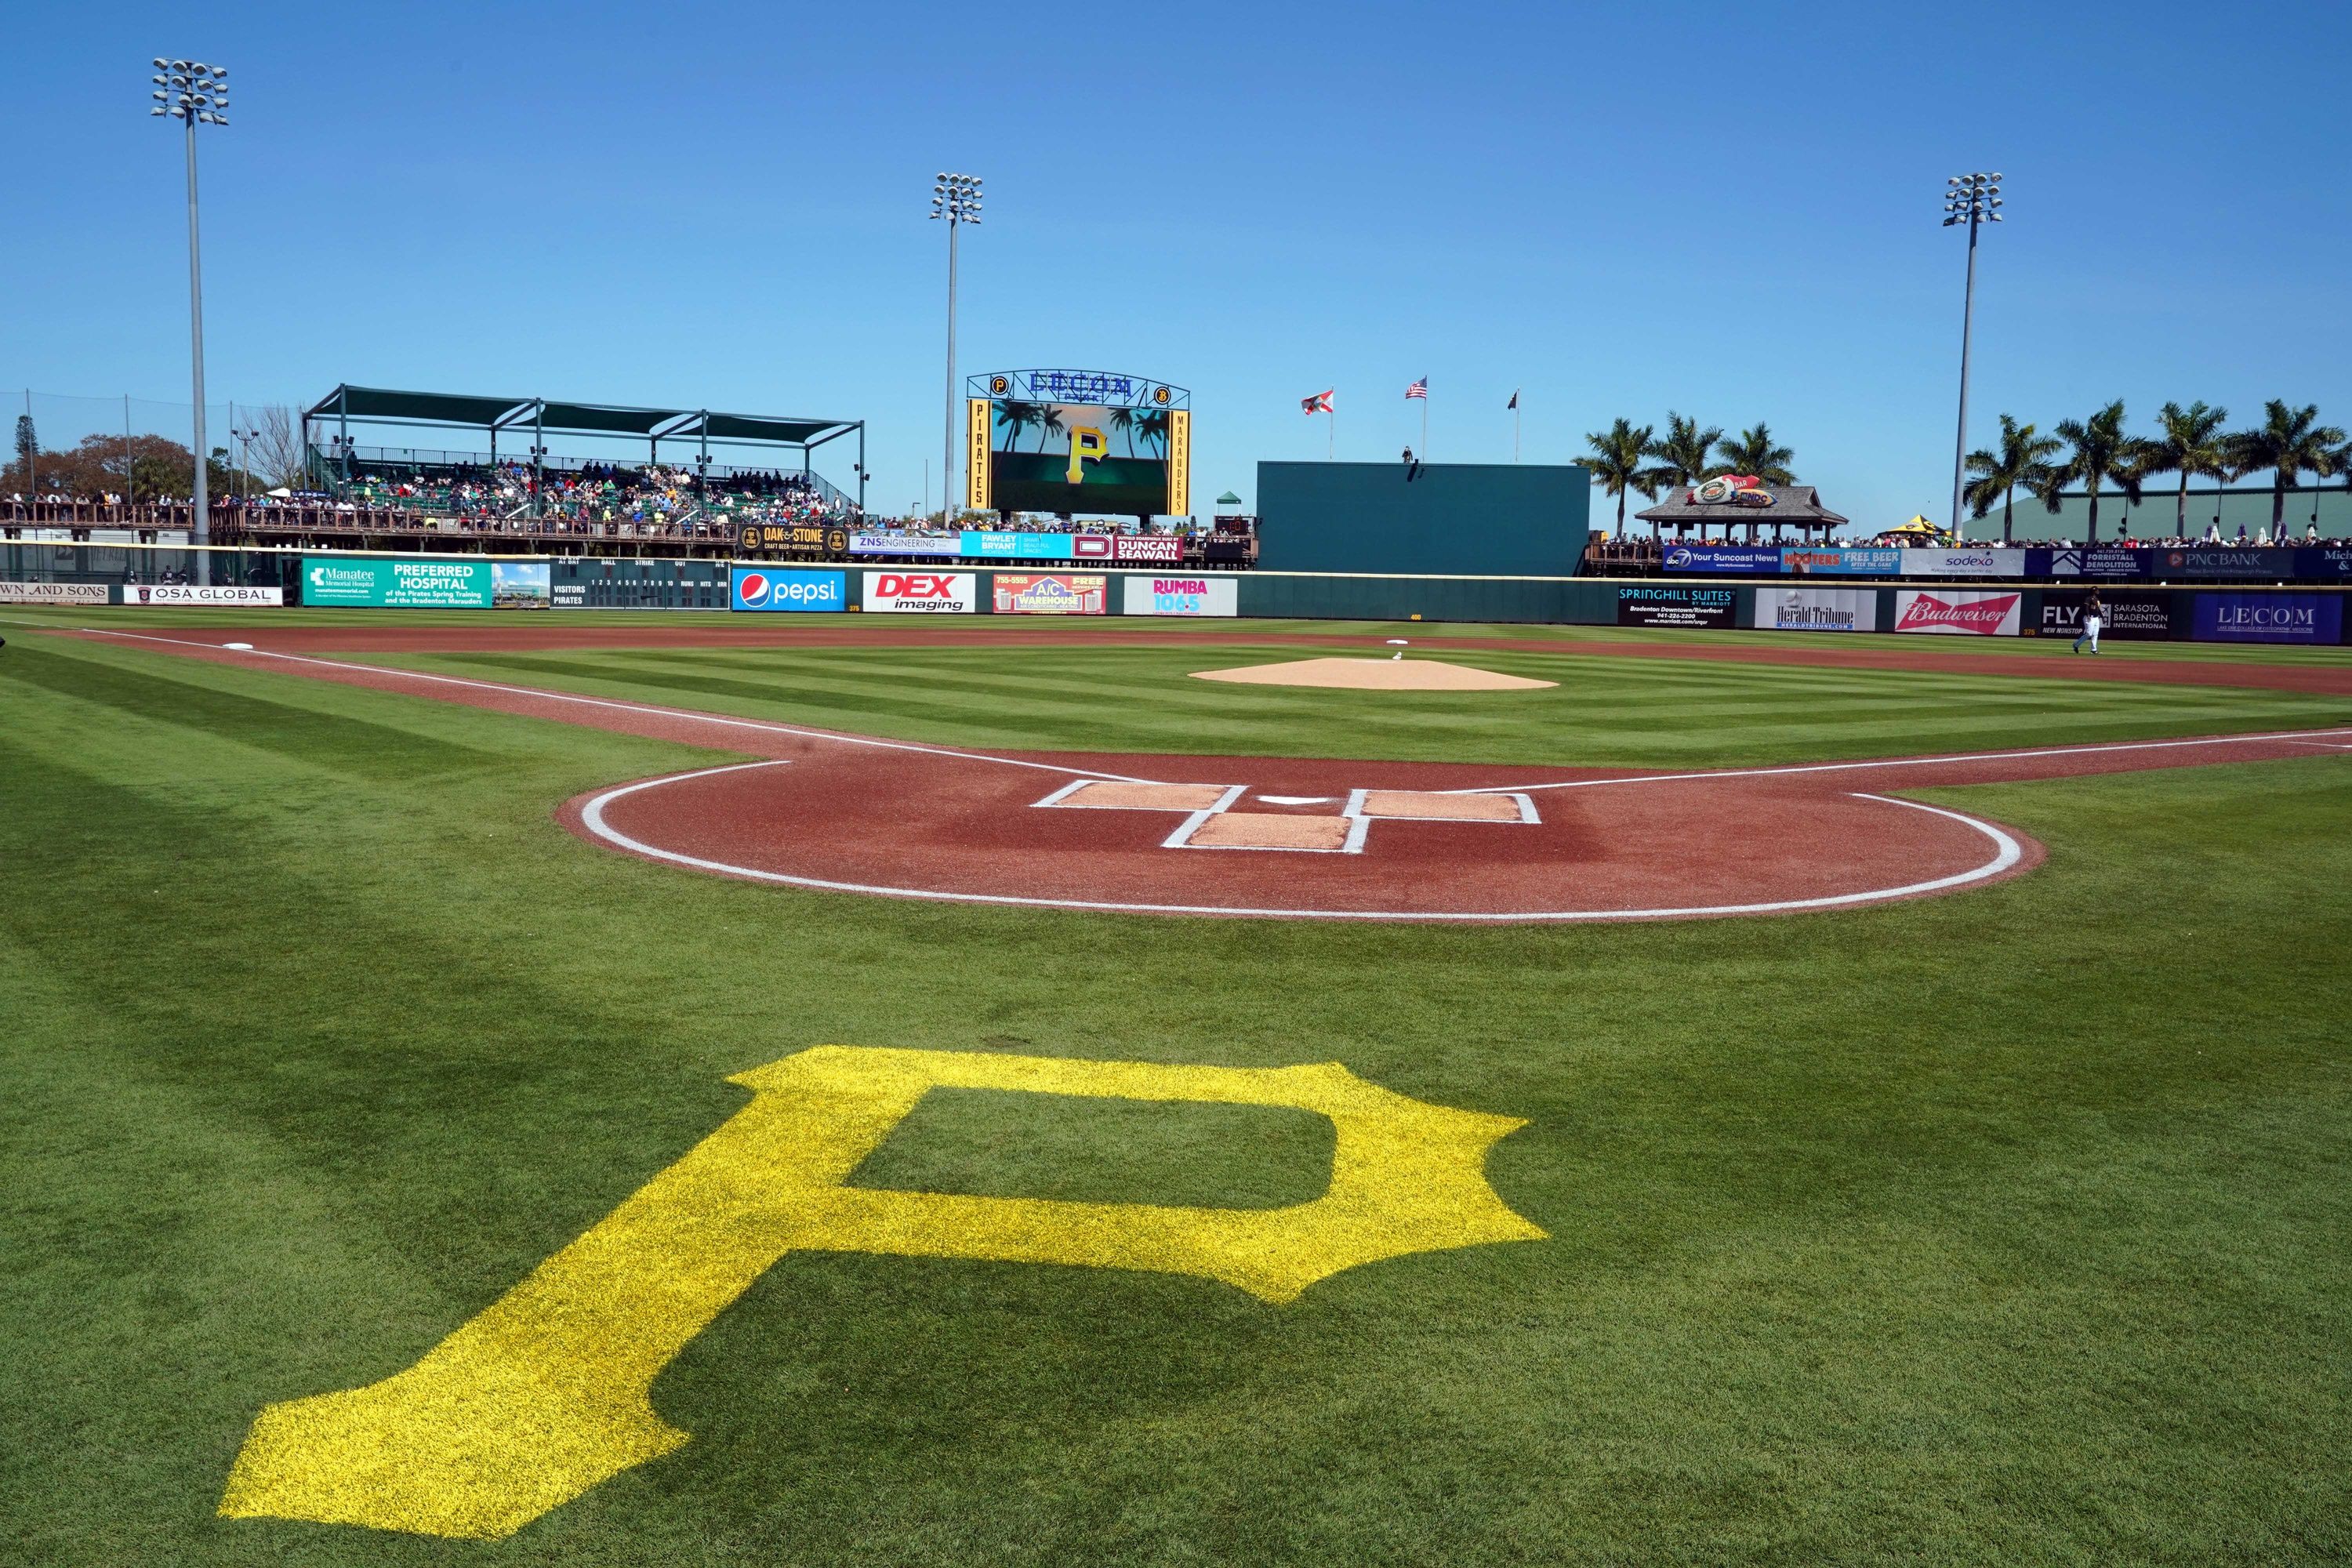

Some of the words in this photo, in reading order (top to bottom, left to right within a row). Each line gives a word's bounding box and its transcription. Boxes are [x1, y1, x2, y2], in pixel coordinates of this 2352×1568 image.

[1029, 373, 1133, 397] LECOM
[1065, 393, 1098, 402] PARK
[1065, 426, 1110, 485] P
[1734, 480, 1748, 488] BAR
[764, 528, 784, 541] OAK
[793, 528, 823, 543] STONE
[1118, 541, 1178, 550] DUNCAN
[1118, 550, 1178, 559] SEAWALL
[1666, 555, 1679, 564] abc
[1693, 553, 1711, 561] Your
[1714, 553, 1753, 561] Suncoast
[1755, 554, 1778, 562] News
[1784, 552, 1840, 565] HOOTERS
[1844, 551, 1870, 562] FREE
[1872, 552, 1899, 562] BEER
[1946, 555, 1994, 566] sodexo
[394, 564, 474, 577] PREFERRED
[2338, 561, 2350, 570] &
[325, 568, 375, 579] Manatee
[400, 577, 468, 590] HOSPITAL
[875, 575, 956, 598] DEX
[1036, 583, 1060, 596] A/C
[1153, 579, 1208, 594] RUMBA
[29, 586, 63, 595] AND
[67, 586, 106, 597] SONS
[156, 588, 193, 598] OSA
[199, 590, 271, 600] GLOBAL
[1619, 588, 1688, 600] SPRINGHILL
[1692, 590, 1731, 601] SUITES
[895, 598, 964, 612] imaging
[1019, 596, 1079, 604] WAREHOUSE
[1153, 594, 1200, 612] 106.5
[1777, 605, 1853, 624] Herald-Tribune
[1906, 601, 2007, 622] Budweiser
[2114, 604, 2160, 612] SARASOTA
[2042, 606, 2080, 624] FLY
[2114, 613, 2169, 622] BRADENTON
[217, 1044, 1549, 1541] P
